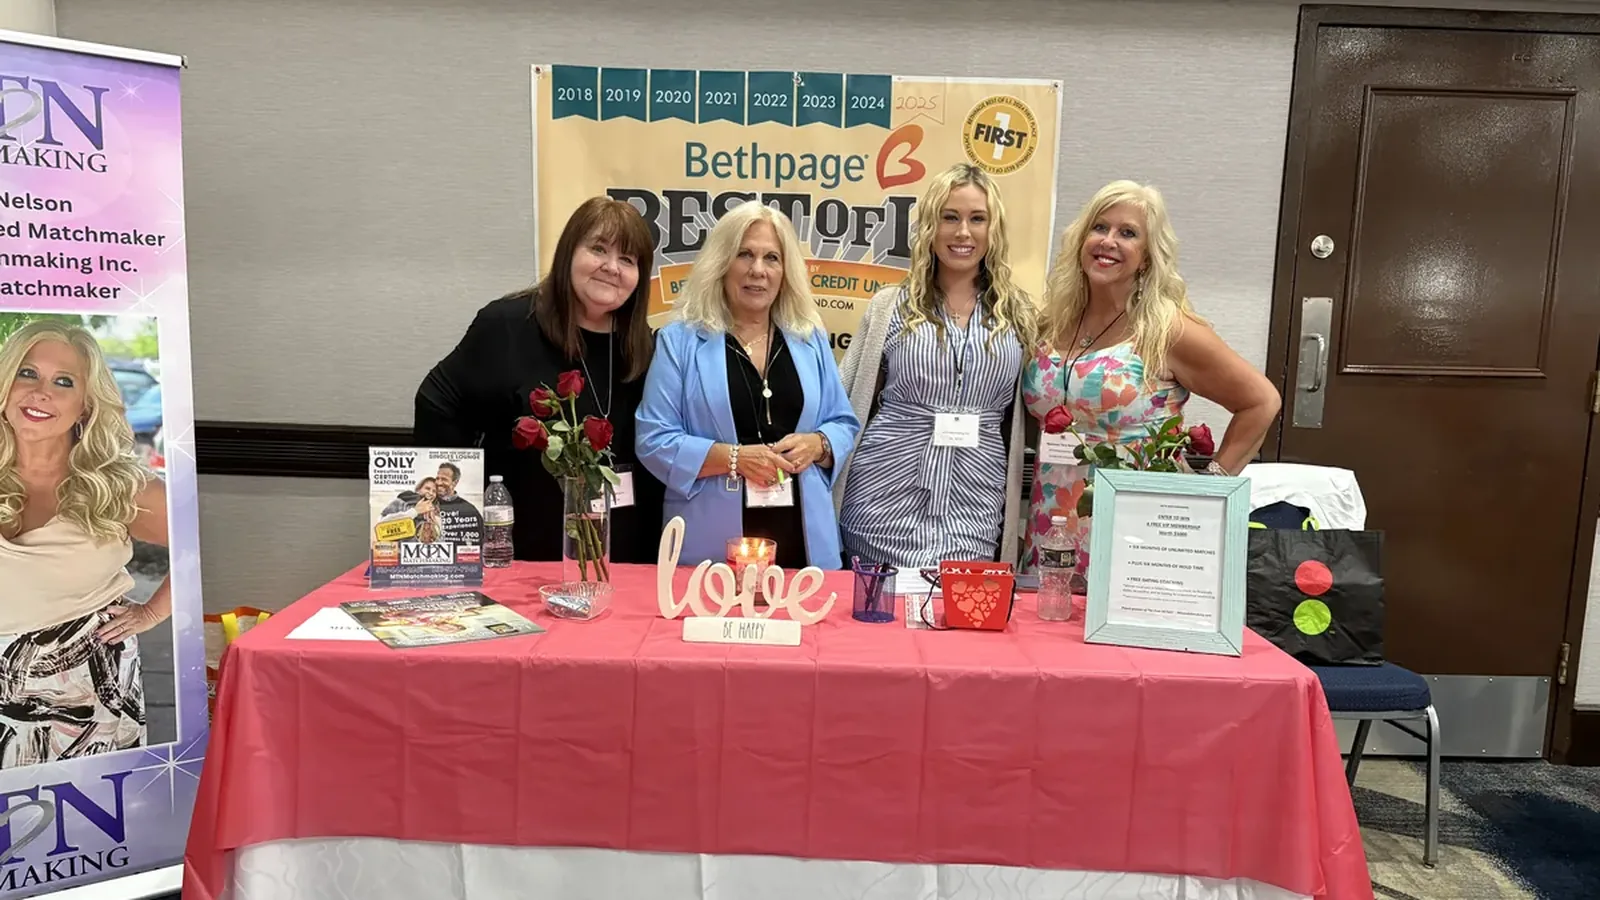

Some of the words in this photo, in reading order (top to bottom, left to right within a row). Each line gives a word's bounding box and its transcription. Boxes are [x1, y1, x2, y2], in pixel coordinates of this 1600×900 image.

[557, 87, 593, 102] 2018
[605, 88, 641, 102] 2019
[655, 90, 692, 104] 2020
[705, 91, 738, 105] 2021
[753, 93, 788, 107] 2022
[802, 94, 836, 109] 2023
[851, 95, 885, 109] 2024
[895, 95, 939, 110] 2025
[973, 122, 1028, 149] FIRST
[685, 141, 865, 189] Bethpage
[0, 192, 72, 213] Nelson
[816, 198, 885, 246] OF
[28, 223, 165, 247] Matchmaker
[99, 255, 138, 273] Inc.
[1, 280, 121, 299] atchmaker
[811, 274, 859, 291] CREDIT
[863, 279, 887, 293] UN
[374, 456, 415, 468] ONLY
[440, 510, 459, 518] Over
[657, 515, 837, 626] love
[723, 621, 733, 639] BE
[738, 621, 766, 640] HAPPY
[0, 846, 130, 891] MAKING
